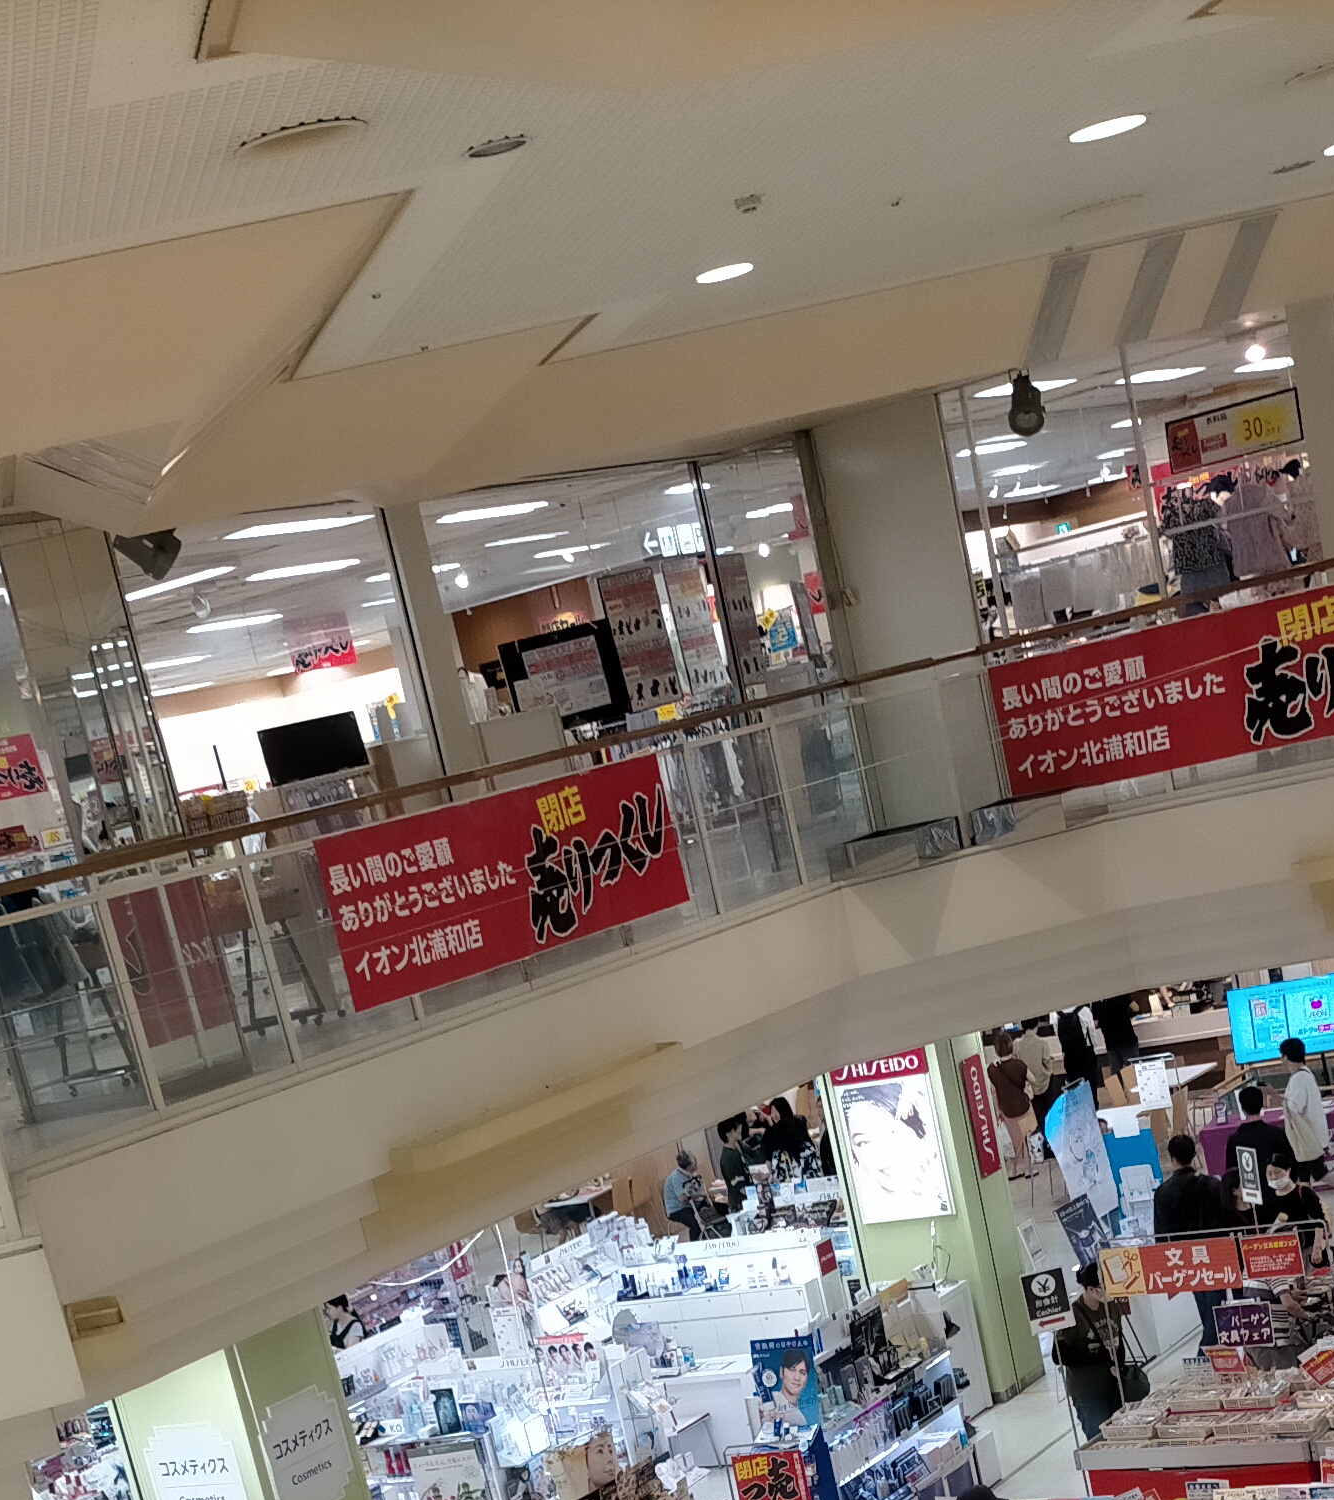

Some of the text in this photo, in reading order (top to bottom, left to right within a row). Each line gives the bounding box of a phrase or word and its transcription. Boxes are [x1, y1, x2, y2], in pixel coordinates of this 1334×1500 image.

[1001, 656, 1147, 711] 長い間のご愛顧
[1007, 671, 1226, 741] ありがとうございました
[1017, 726, 1171, 780] イオン北浦和店
[536, 785, 586, 836] 閉店
[328, 836, 455, 895] 長い間のご愛顧
[524, 784, 667, 944] 売りつくし
[338, 861, 516, 933] ありがとうございました
[355, 918, 484, 983] イオン北浦和店
[835, 1055, 919, 1082] SHISEIDO
[969, 1066, 996, 1164] SHISEIDO
[1148, 1265, 1237, 1291] バーゲンセール
[1165, 1244, 1211, 1267] 文具
[1218, 1328, 1272, 1345] 文具フェア
[1230, 1312, 1270, 1327] バーゲン
[272, 1416, 335, 1462] コスメティクス
[158, 1455, 231, 1478] コスメティクス
[290, 1457, 334, 1488] Cosmetics
[735, 1457, 768, 1480] 閉店
